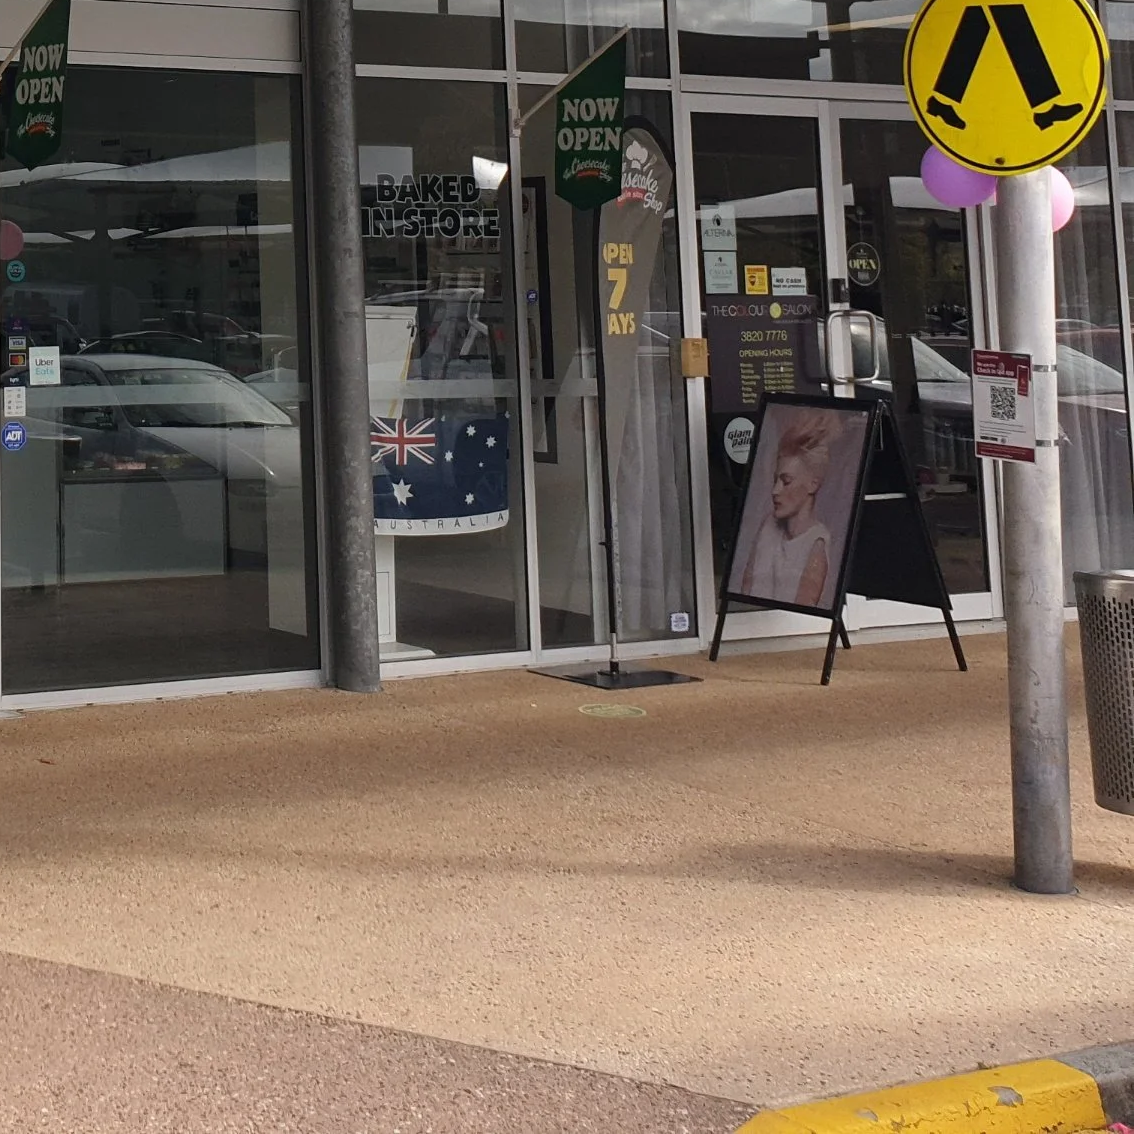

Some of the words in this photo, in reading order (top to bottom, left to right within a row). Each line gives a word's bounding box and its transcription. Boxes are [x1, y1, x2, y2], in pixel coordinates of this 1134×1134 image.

[22, 43, 65, 73] NOW
[16, 76, 65, 105] OPEN
[562, 97, 620, 123] NOW
[558, 127, 623, 152] OPEN
[376, 173, 481, 204] BAKED
[361, 207, 396, 238] IN
[402, 207, 501, 238] STORE
[849, 257, 877, 269] OPEN
[607, 268, 627, 310] 7
[741, 330, 763, 342] 3820
[766, 330, 788, 342] 7776
[35, 358, 54, 367] Uber
[739, 349, 769, 358] OPENING
[769, 348, 793, 357] HOURS
[6, 431, 22, 441] ADT
[374, 512, 504, 530] AUSTRALIA
